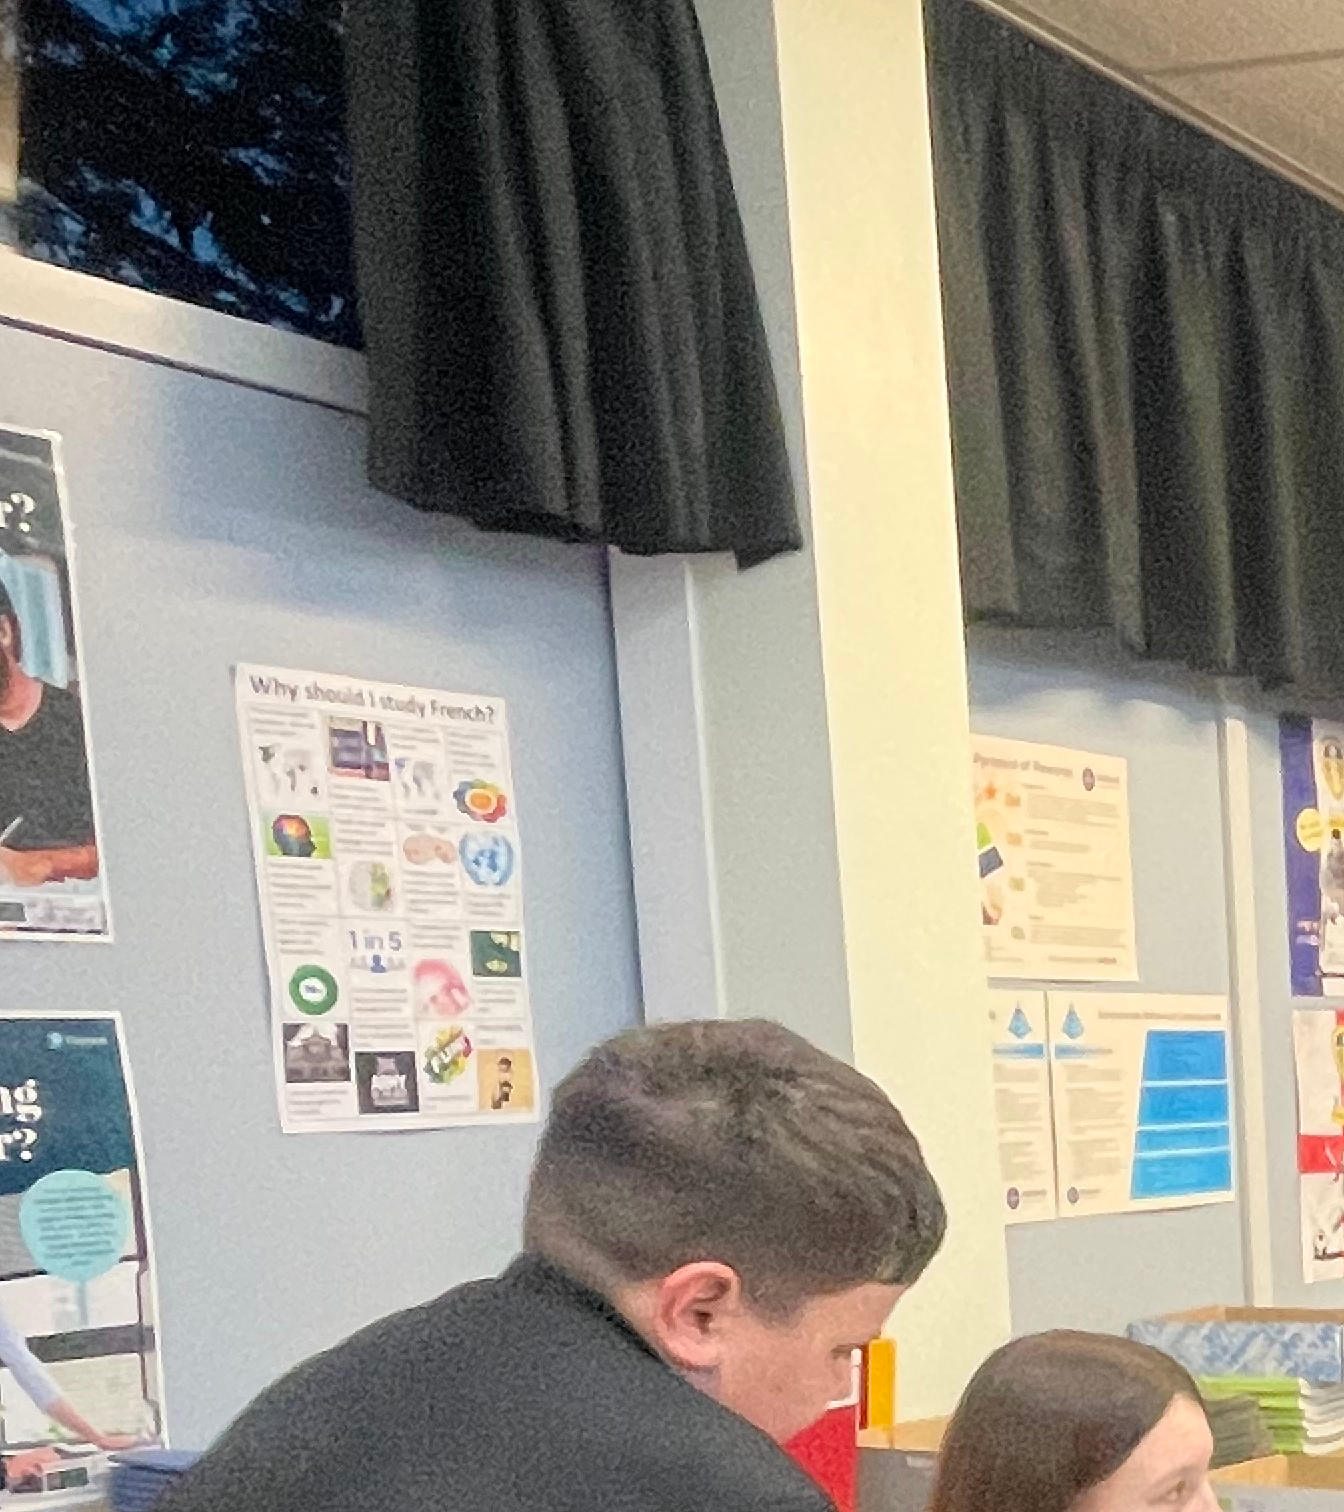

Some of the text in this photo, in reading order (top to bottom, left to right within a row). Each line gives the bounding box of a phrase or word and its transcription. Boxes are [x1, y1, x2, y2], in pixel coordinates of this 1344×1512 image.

[248, 673, 299, 703] Why
[304, 681, 366, 708] should
[429, 697, 495, 726] French?
[349, 929, 403, 952] 1 in 5
